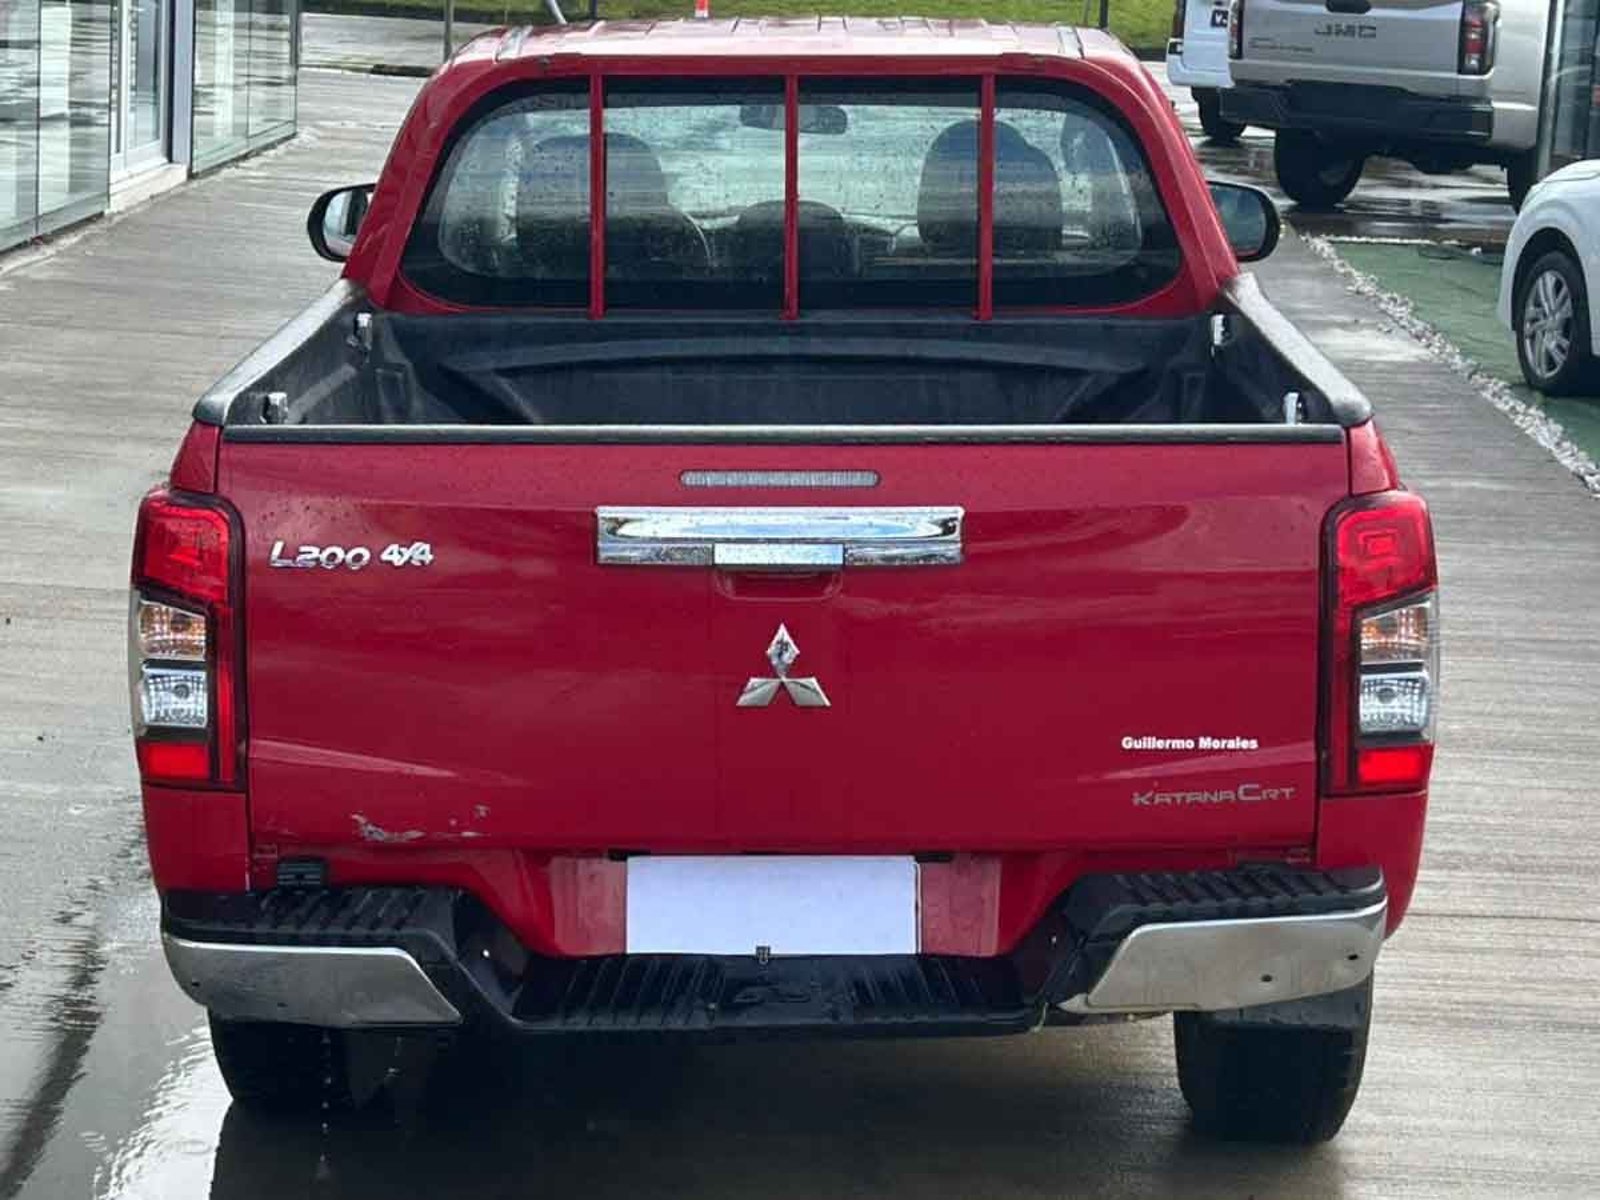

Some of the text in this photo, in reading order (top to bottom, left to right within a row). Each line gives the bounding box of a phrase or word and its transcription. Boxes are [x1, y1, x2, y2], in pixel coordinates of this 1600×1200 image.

[269, 540, 371, 570] L200
[1121, 736, 1259, 750] Guillermo Morales
